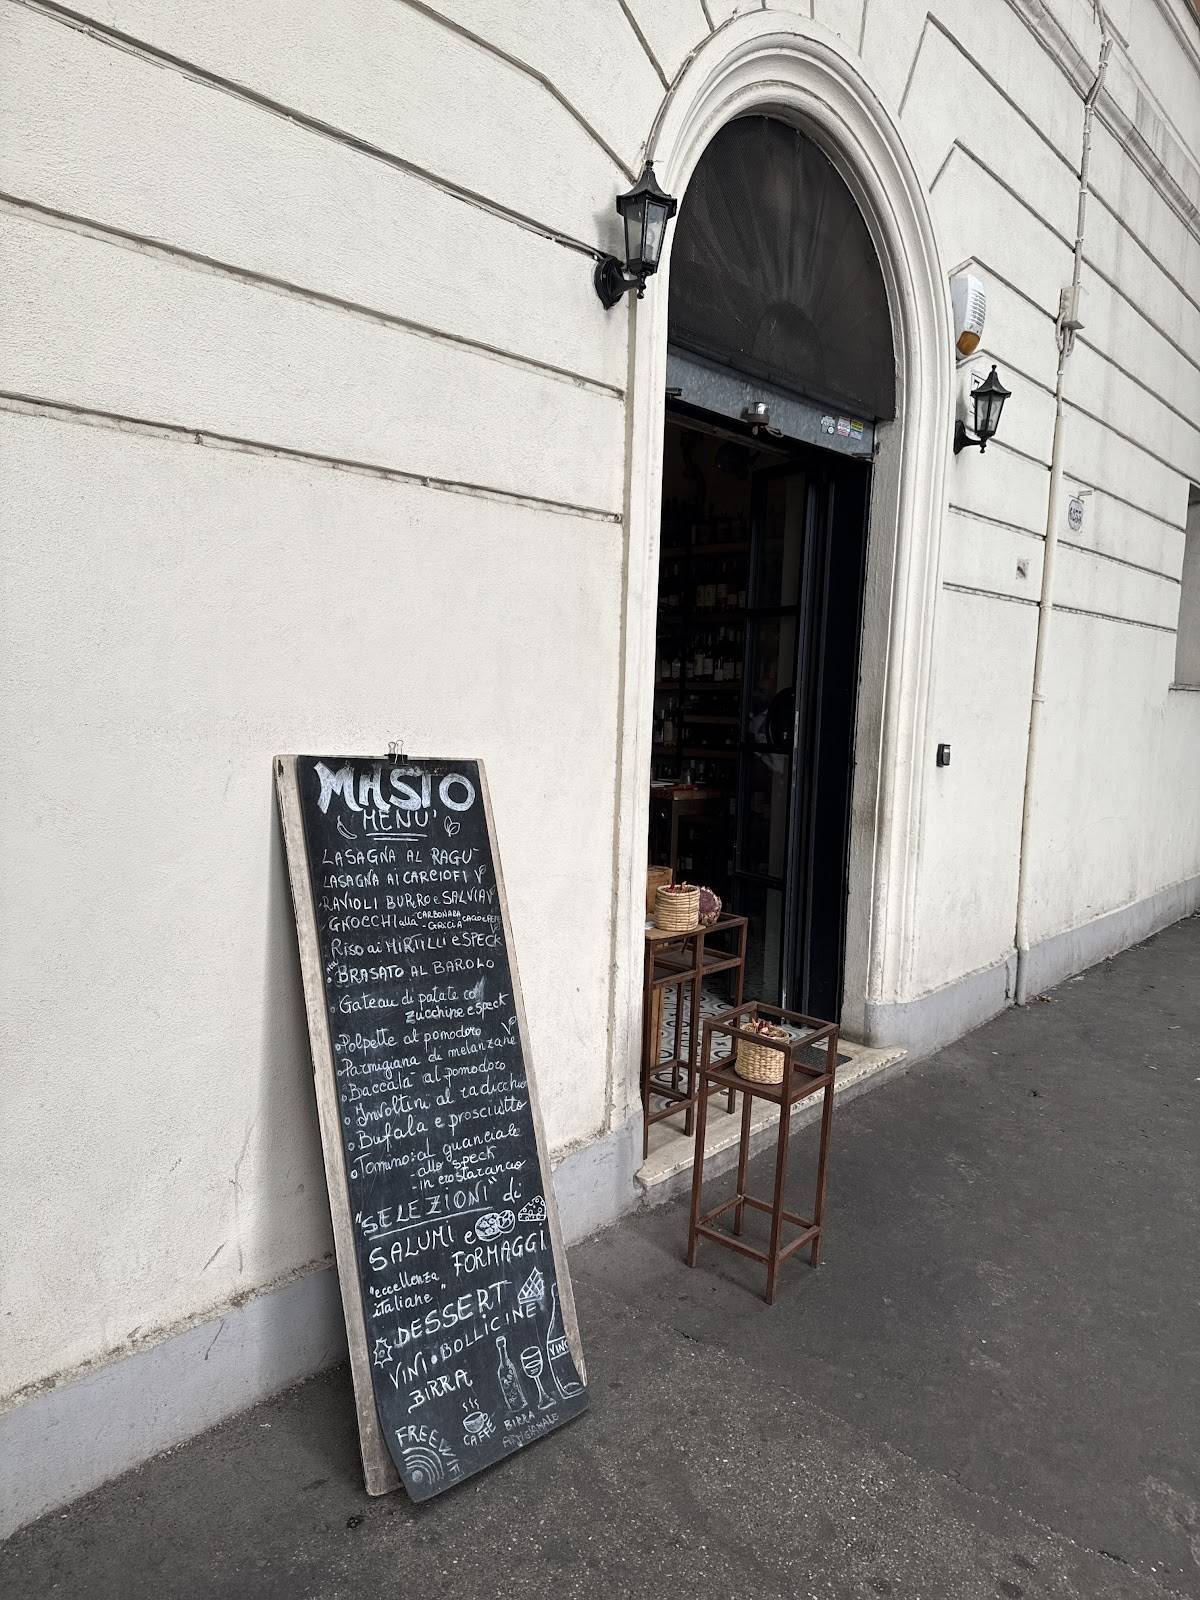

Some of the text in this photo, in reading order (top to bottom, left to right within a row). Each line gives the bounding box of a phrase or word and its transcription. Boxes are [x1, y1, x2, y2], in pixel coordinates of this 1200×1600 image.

[322, 846, 396, 866] LASAGNA
[407, 850, 422, 863] AL
[323, 870, 379, 888] LASAGNA
[322, 892, 378, 911] RAVIOLI
[336, 957, 495, 985] BRASATO AL BAROLO
[339, 992, 399, 1014] Gateau
[402, 987, 415, 1005] di
[418, 985, 459, 1011] patate
[404, 1005, 465, 1024] zucchine
[338, 1028, 398, 1056] Polpette
[423, 1024, 482, 1053] pomodoro
[341, 1035, 517, 1080] Parmigiana di melanzane
[423, 1064, 441, 1084] al
[443, 1055, 506, 1088] pomodoro
[436, 1086, 457, 1107] al
[355, 1096, 528, 1152] Bufala e prosciutto
[416, 1136, 436, 1162] al
[442, 1122, 521, 1161] guanciale
[451, 1144, 498, 1169] speck
[502, 1176, 523, 1204] di
[451, 1222, 548, 1277] FORMAGGI
[464, 1231, 477, 1244] e
[394, 1279, 513, 1347] DESSERT
[407, 1369, 474, 1414] BIRRA
[394, 1424, 440, 1449] FREE
